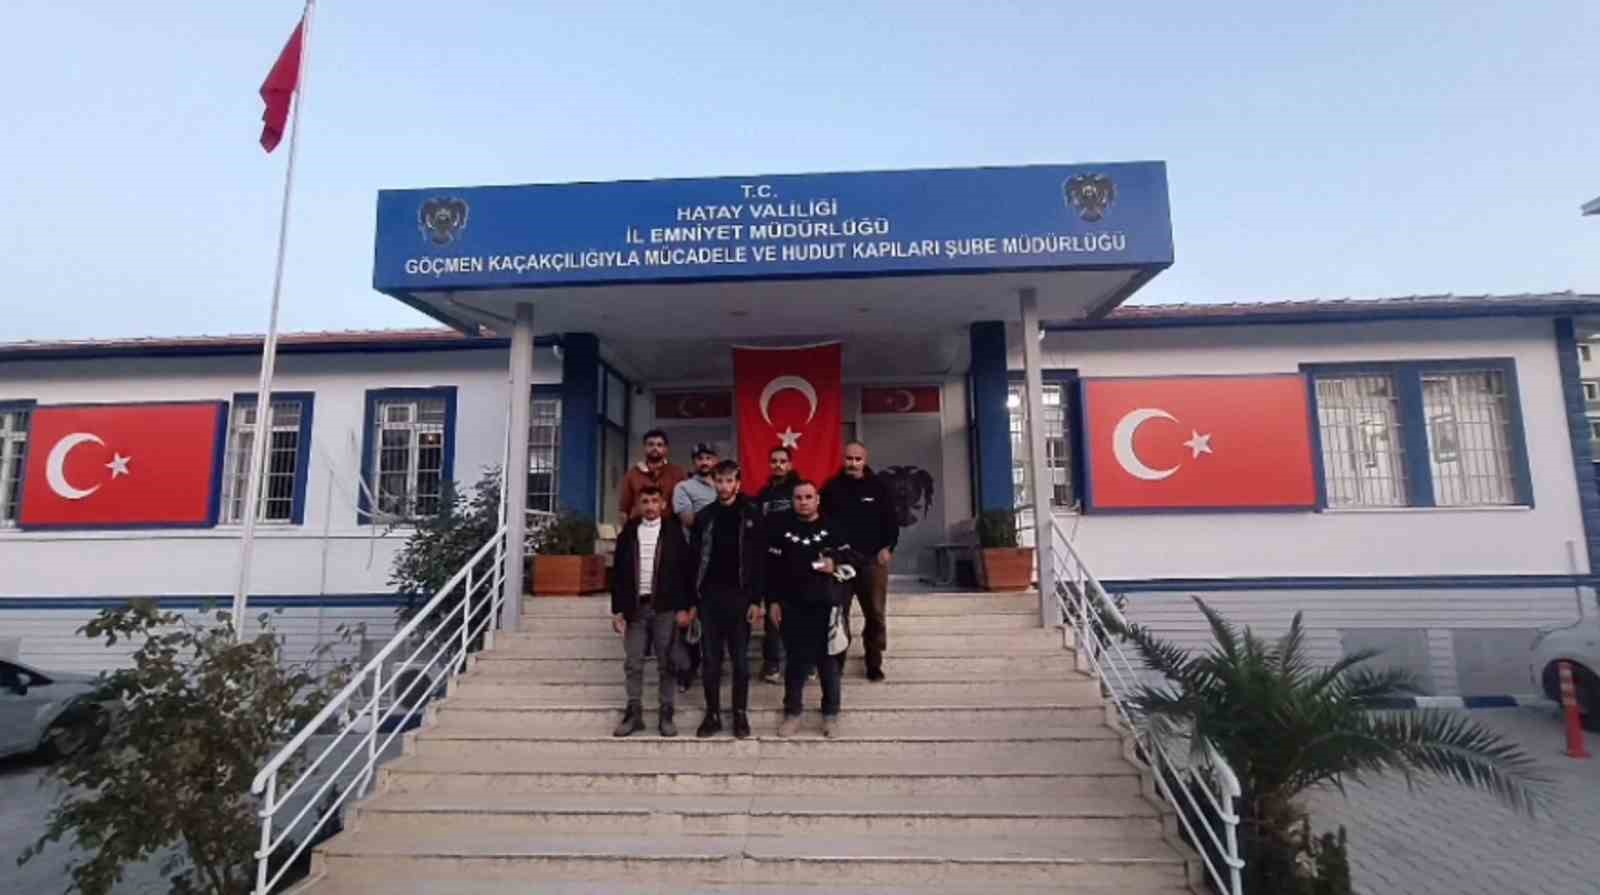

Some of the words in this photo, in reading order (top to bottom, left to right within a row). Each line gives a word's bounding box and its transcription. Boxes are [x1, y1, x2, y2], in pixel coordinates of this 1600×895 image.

[741, 184, 778, 198] T.C.
[677, 205, 743, 221] HATAY
[750, 198, 837, 219] VALİLİĞİ
[626, 225, 645, 244] İL
[650, 223, 744, 243] EMNİYET
[750, 217, 889, 239] MÜDÜRLÜĞÜ
[405, 256, 483, 278] GÖÇMEN
[488, 248, 640, 274] KAÇAKÇILIĞIYLA
[644, 245, 747, 265] MÜCADELE
[752, 245, 777, 262] VE
[782, 243, 846, 261] HUDUT
[852, 239, 940, 259] KAPILARI
[945, 238, 997, 259] ŞUBE
[1002, 230, 1126, 254] MÜDÜRLÜĞÜ
